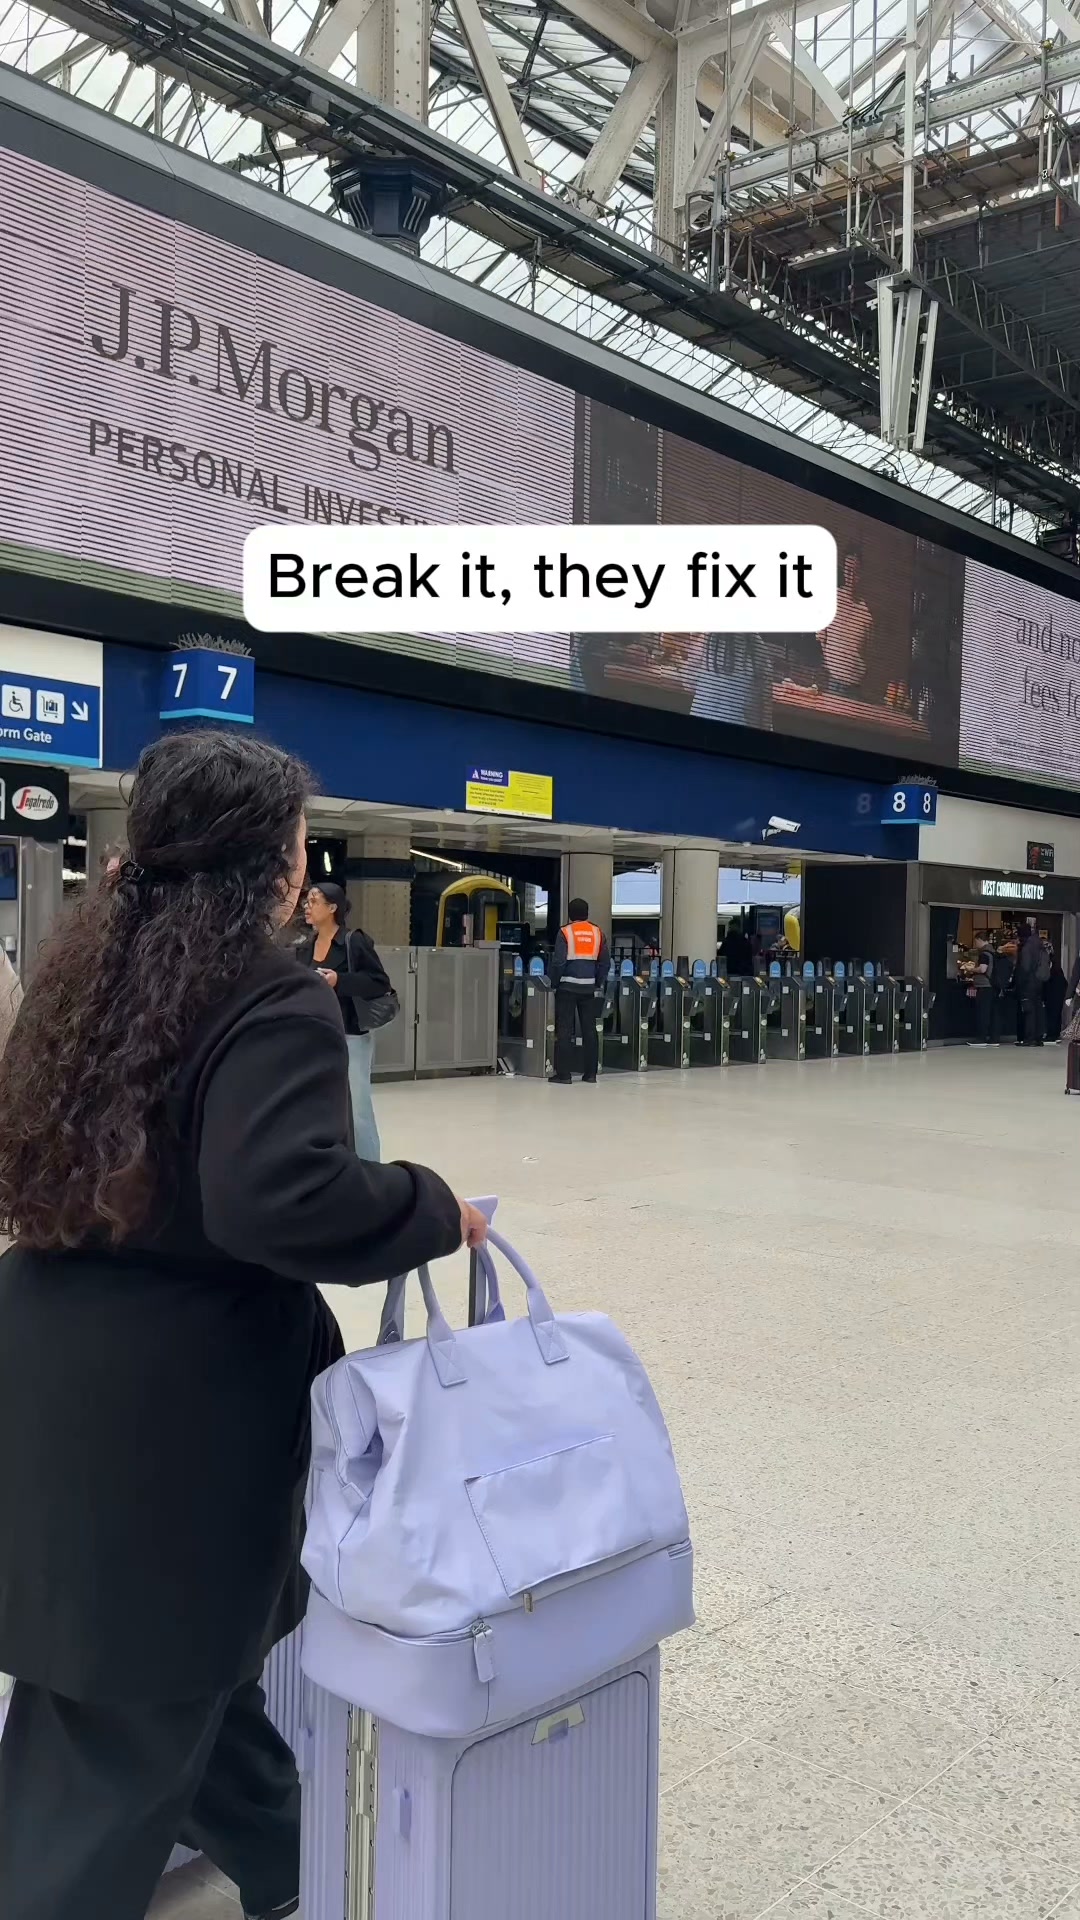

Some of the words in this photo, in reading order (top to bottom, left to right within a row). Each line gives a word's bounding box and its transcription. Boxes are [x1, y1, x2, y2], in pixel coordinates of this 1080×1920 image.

[92, 281, 459, 474] J.P.Morgan
[89, 418, 289, 513] PERSONAL
[1016, 614, 1053, 653] and
[172, 663, 188, 698] 7
[217, 664, 238, 700] 7
[1024, 664, 1060, 714] fees
[23, 727, 53, 743] Gate
[480, 769, 504, 779] WARNING
[16, 788, 55, 810] Segafredo
[892, 791, 906, 813] 8
[923, 792, 931, 814] 8
[981, 879, 996, 896] WEST
[996, 881, 1021, 898] CORNWALL
